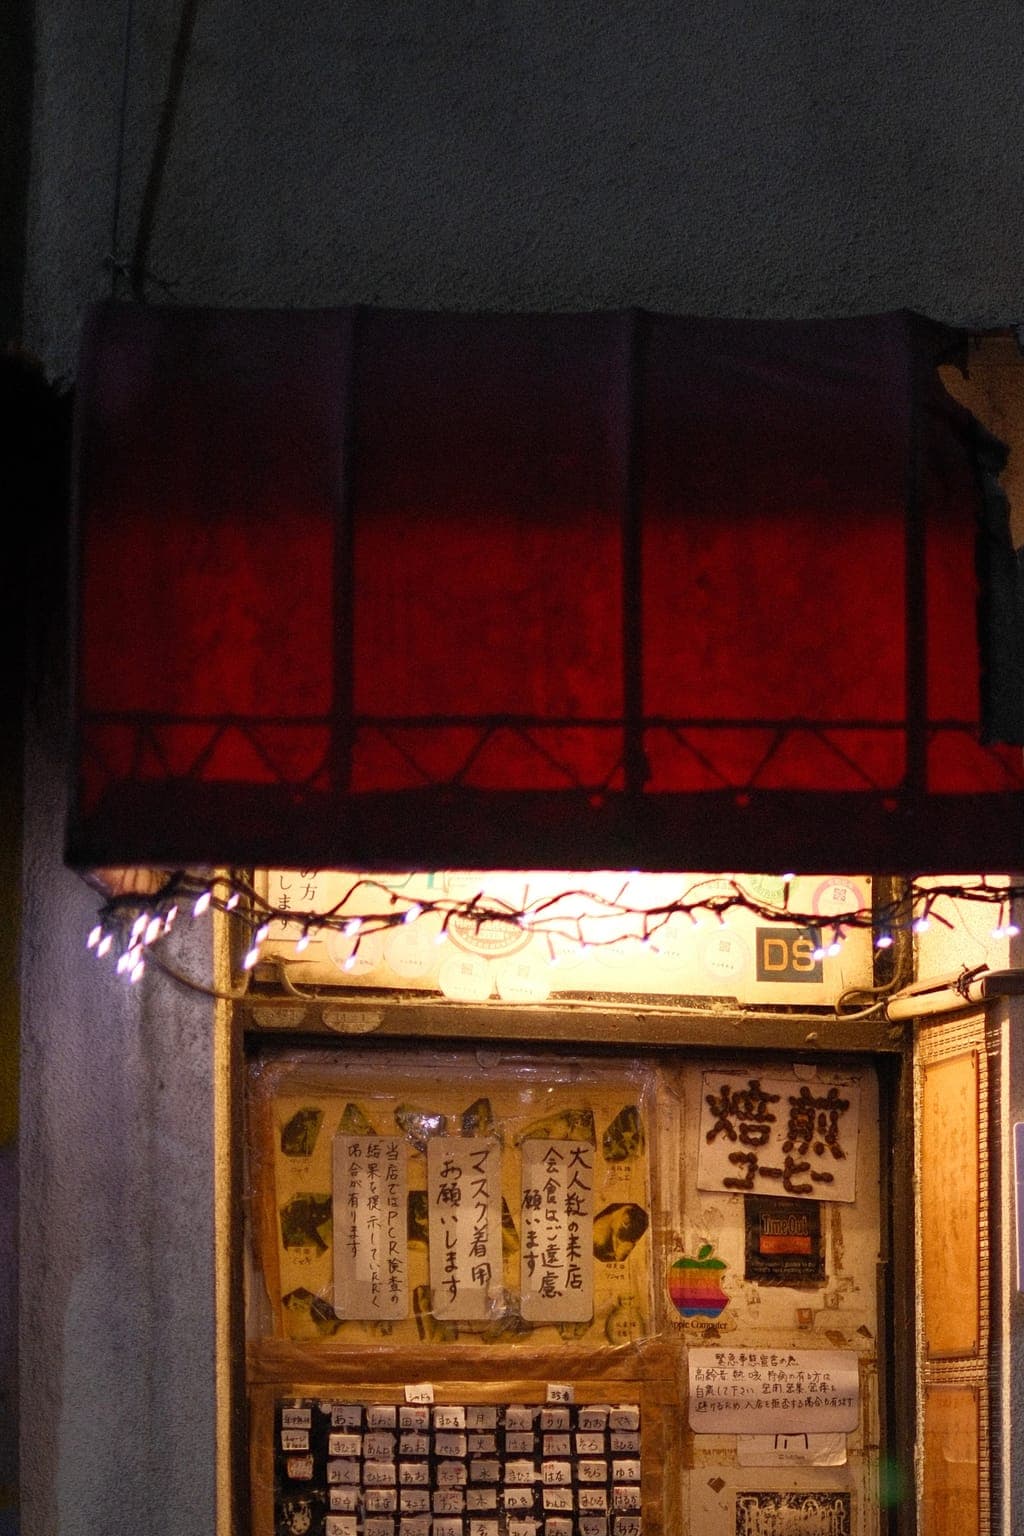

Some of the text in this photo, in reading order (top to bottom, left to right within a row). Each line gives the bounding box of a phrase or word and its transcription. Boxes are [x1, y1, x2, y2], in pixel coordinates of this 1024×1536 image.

[763, 938, 815, 972] DS
[723, 1151, 834, 1194] コーヒー
[437, 1159, 463, 1304] お願いします
[469, 1150, 492, 1285] マスク着用
[521, 1189, 543, 1278] 願います
